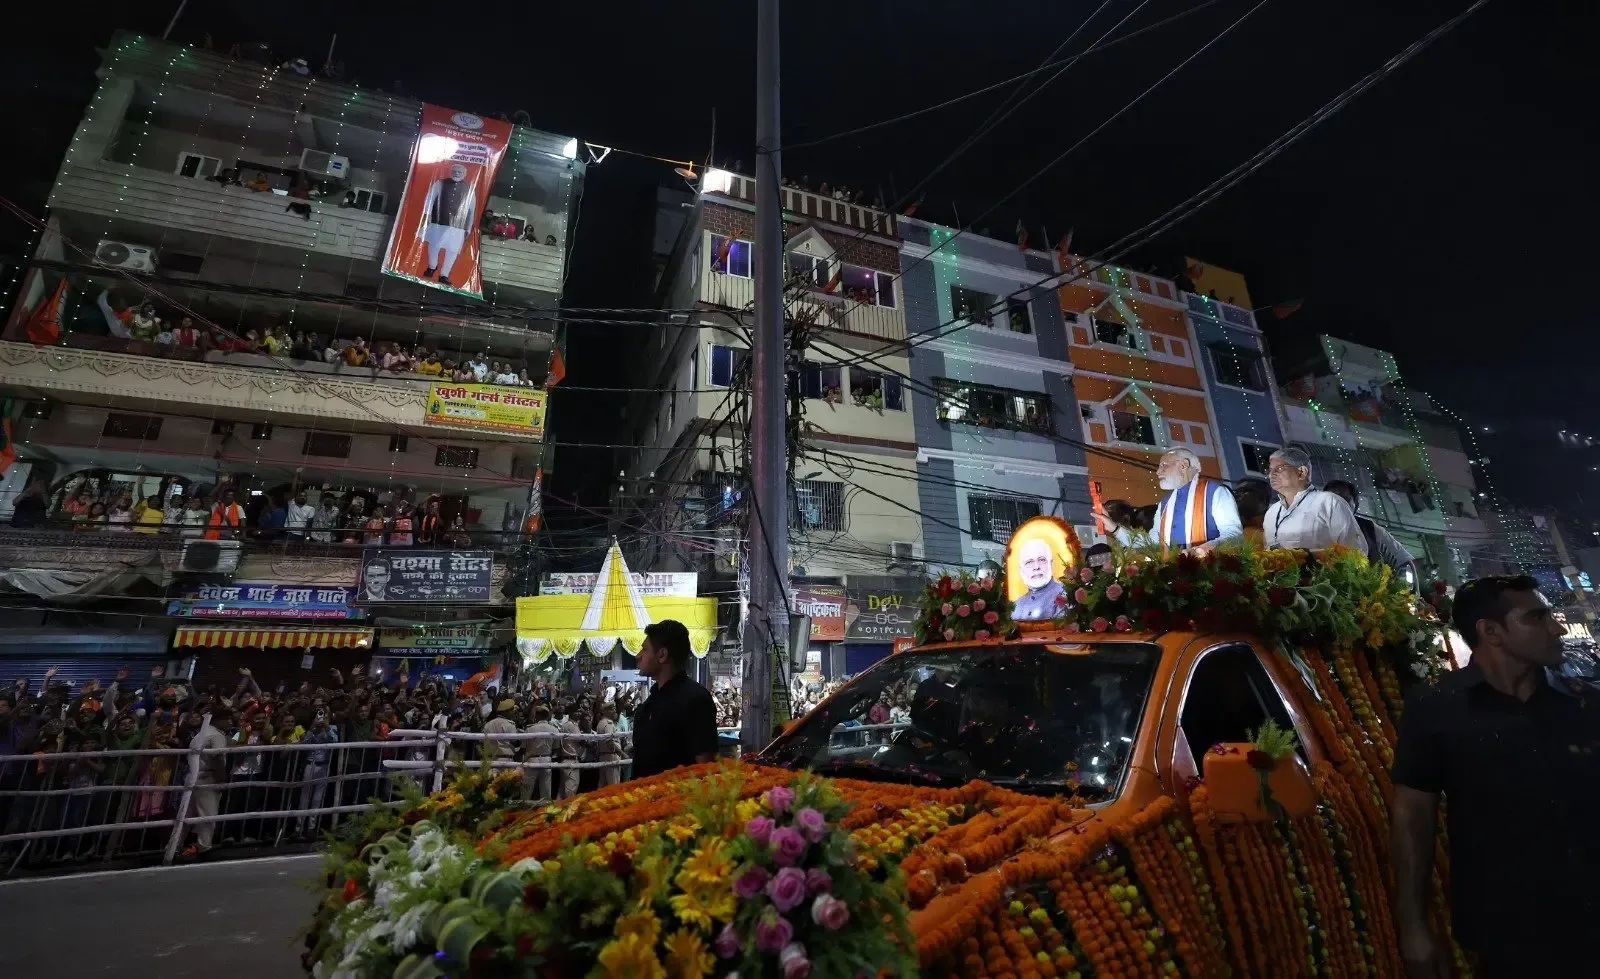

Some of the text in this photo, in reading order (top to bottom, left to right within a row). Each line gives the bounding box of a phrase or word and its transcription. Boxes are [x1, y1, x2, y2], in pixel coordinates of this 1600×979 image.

[435, 386, 468, 400] खुशी
[471, 391, 500, 403] गर्ल्स
[503, 394, 542, 408] हॉस्टल
[391, 553, 491, 571] चश्मा सेंटर
[402, 571, 424, 580] चश्मे
[429, 571, 445, 580] की
[199, 583, 350, 606] देवेन्द्र भाई जूस वाले
[865, 626, 908, 634] OPTICAL
